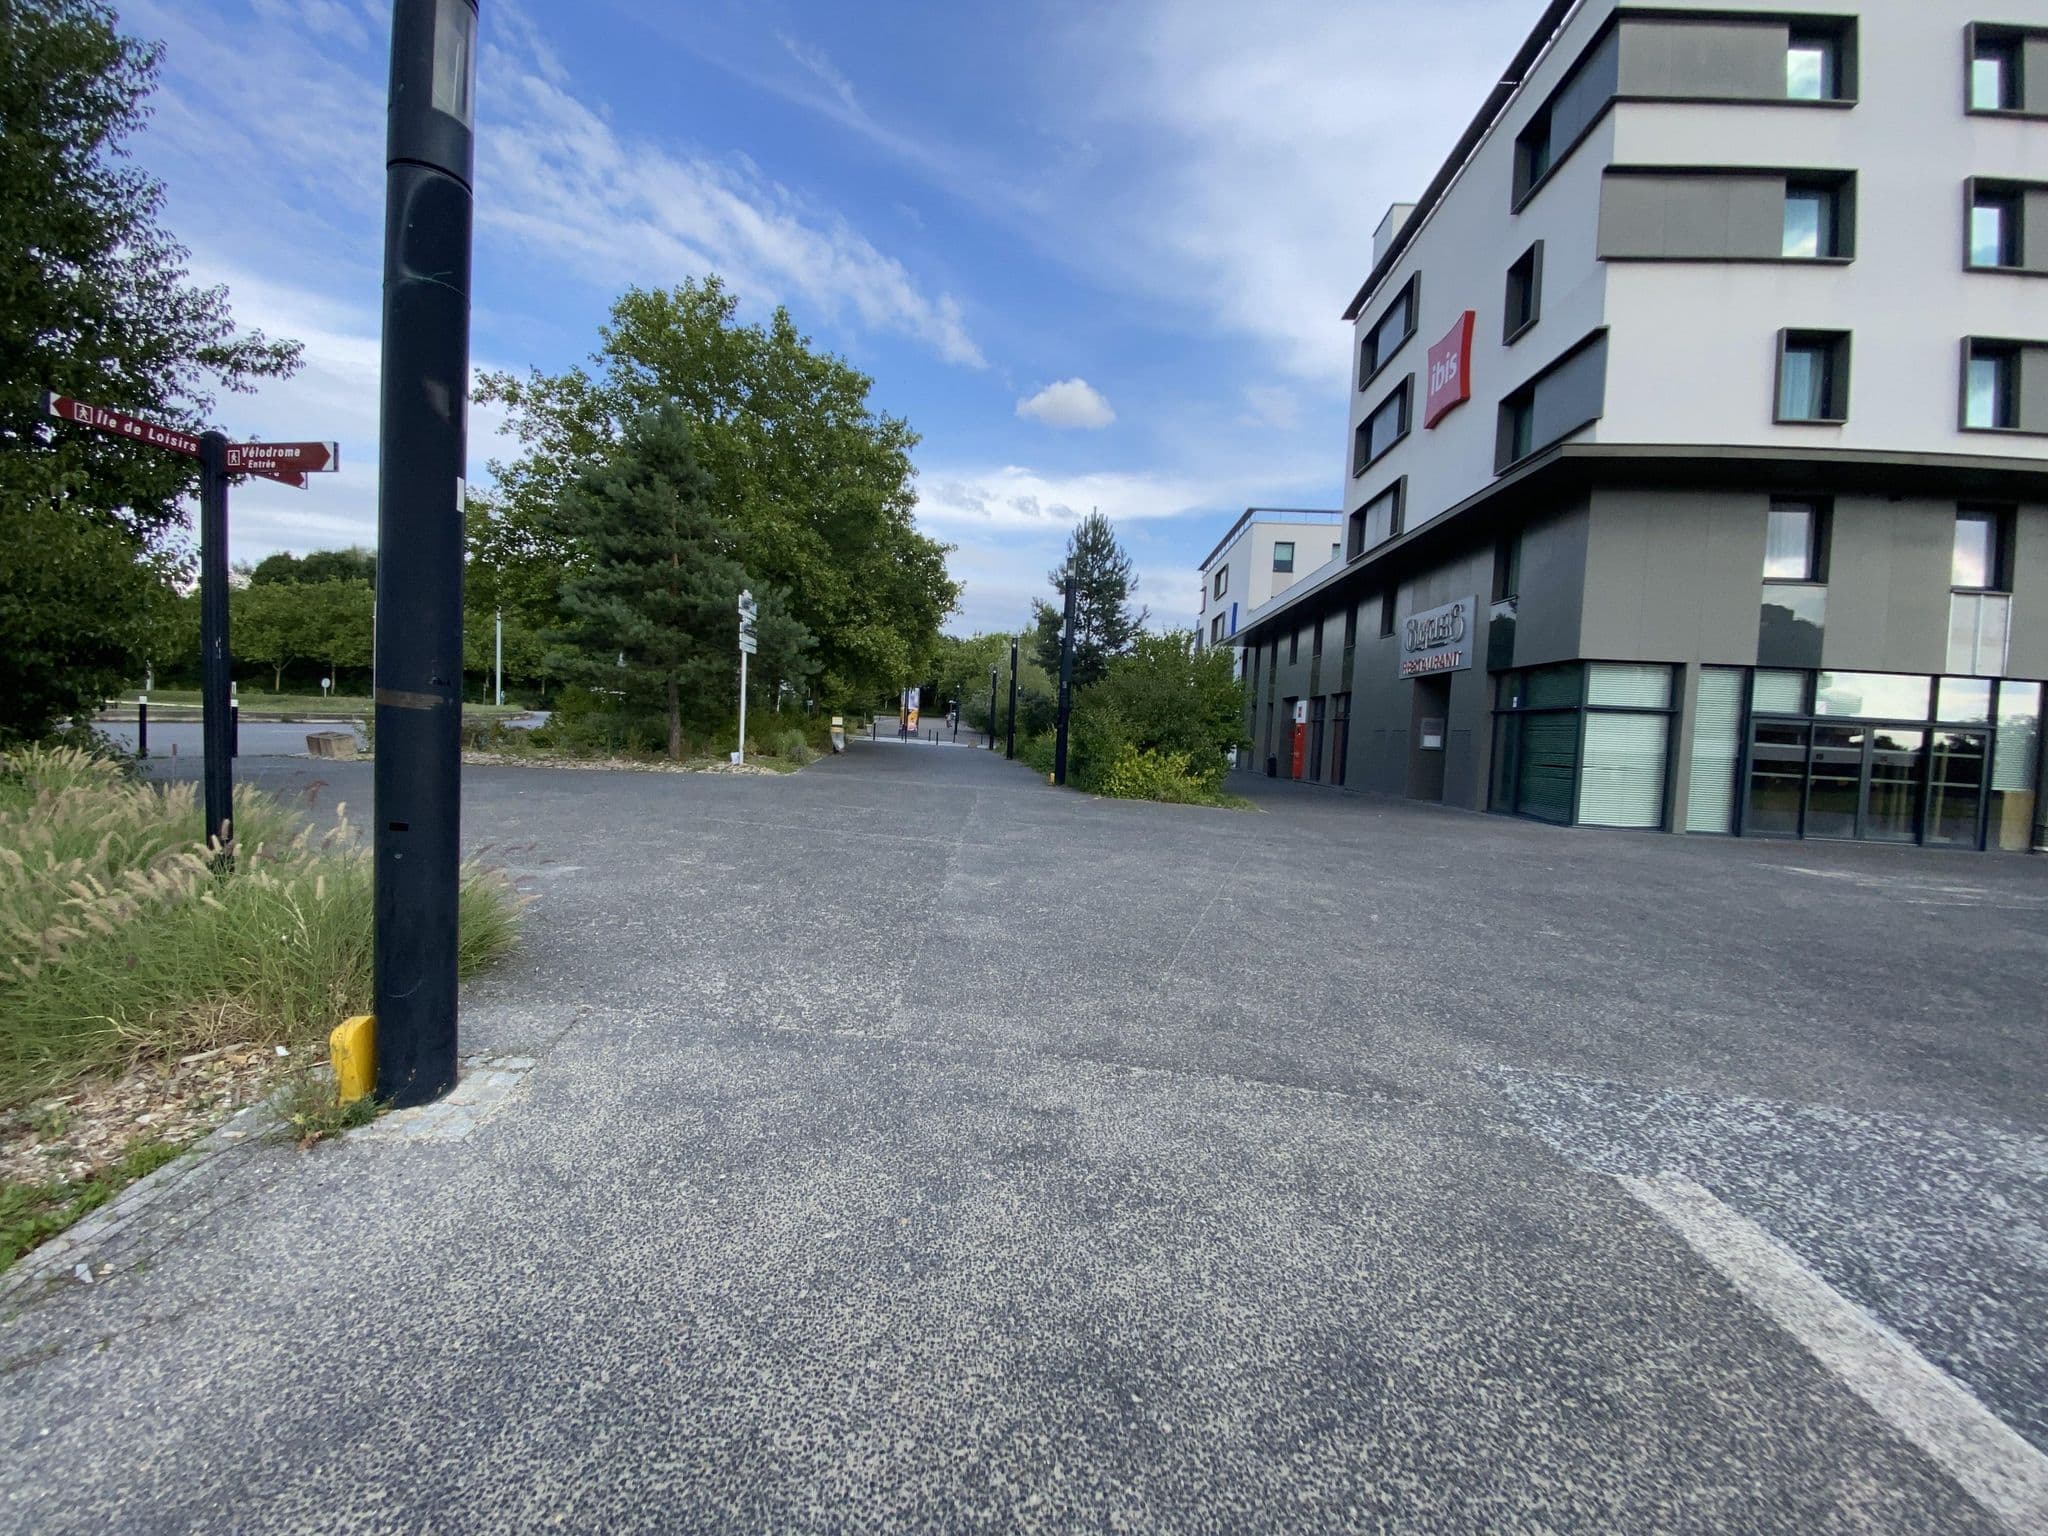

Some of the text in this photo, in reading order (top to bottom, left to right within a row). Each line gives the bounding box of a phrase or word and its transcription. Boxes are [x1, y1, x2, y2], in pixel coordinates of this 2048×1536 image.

[1431, 352, 1458, 396] ibis
[97, 409, 197, 452] Île de Loisirs
[241, 446, 301, 459] Vélodrome
[248, 460, 276, 469] Entrée
[1403, 650, 1463, 675] RESTAURANT
